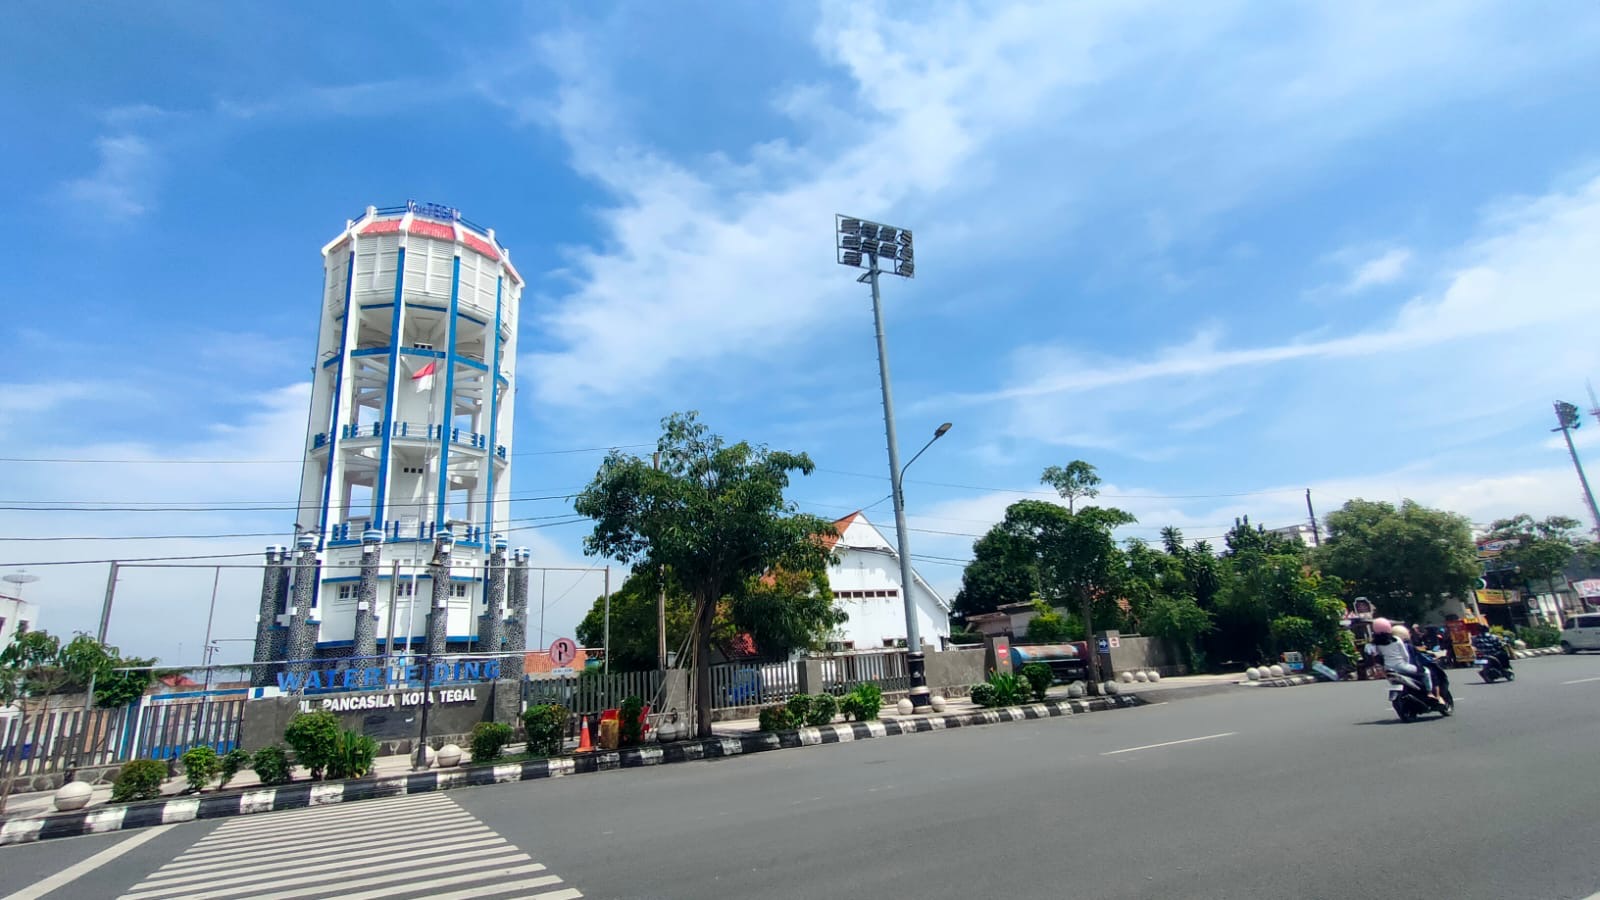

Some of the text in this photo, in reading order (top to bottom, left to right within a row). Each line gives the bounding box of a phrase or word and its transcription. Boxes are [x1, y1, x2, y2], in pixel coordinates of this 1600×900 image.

[322, 694, 396, 712] PANCASILA
[402, 691, 434, 706] KOTA
[440, 687, 477, 703] TEGAL
